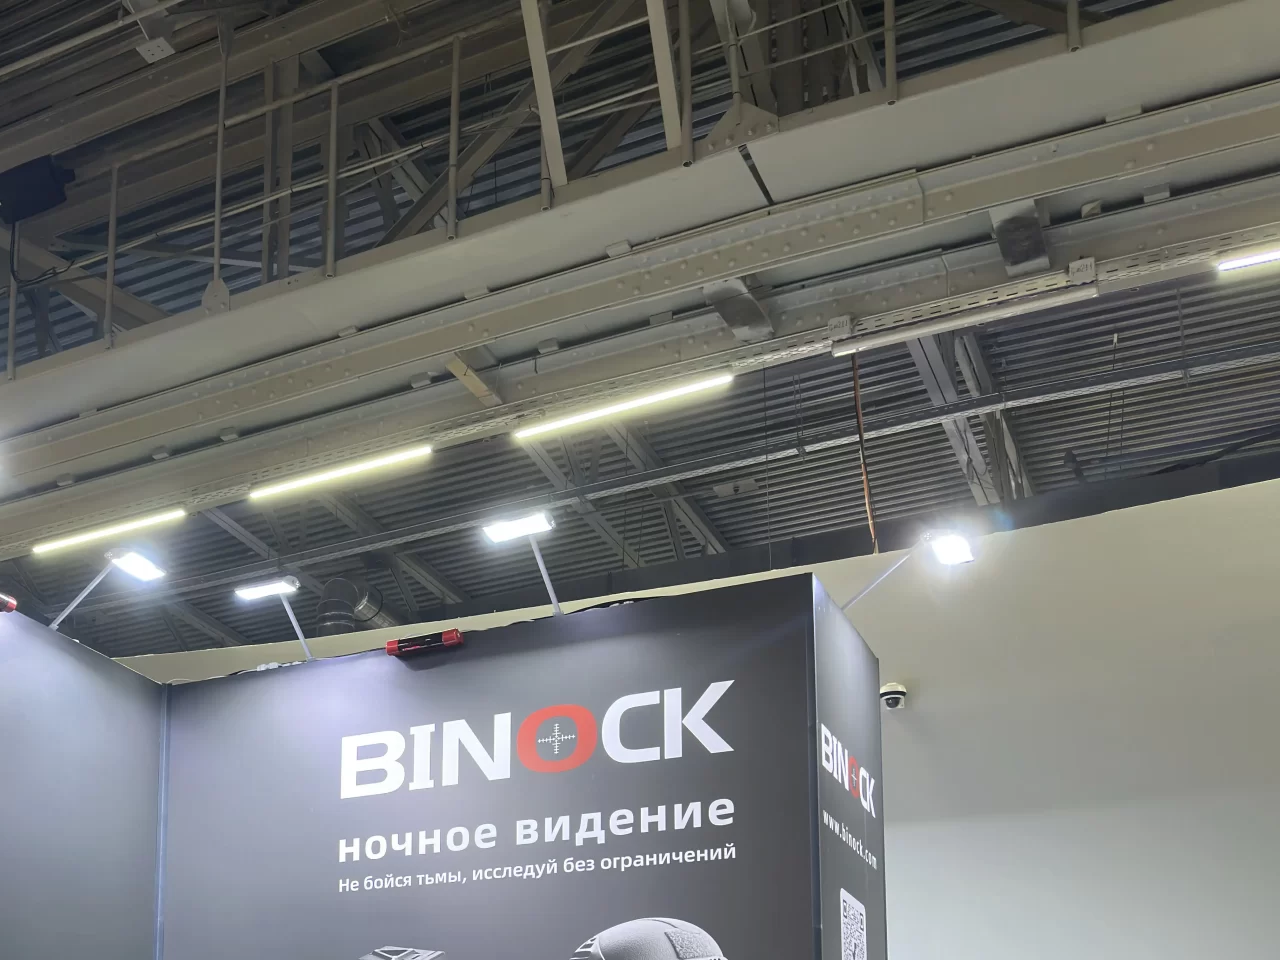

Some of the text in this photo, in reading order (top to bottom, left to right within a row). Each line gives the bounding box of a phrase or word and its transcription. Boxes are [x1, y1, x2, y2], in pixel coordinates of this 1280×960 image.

[340, 680, 735, 799] BINOCK
[821, 723, 876, 818] BINOCK
[339, 798, 735, 862] ночное видение
[823, 810, 877, 870] www.binock.com
[339, 843, 736, 892] Не бойся тьмы, исследуй без ограничений
